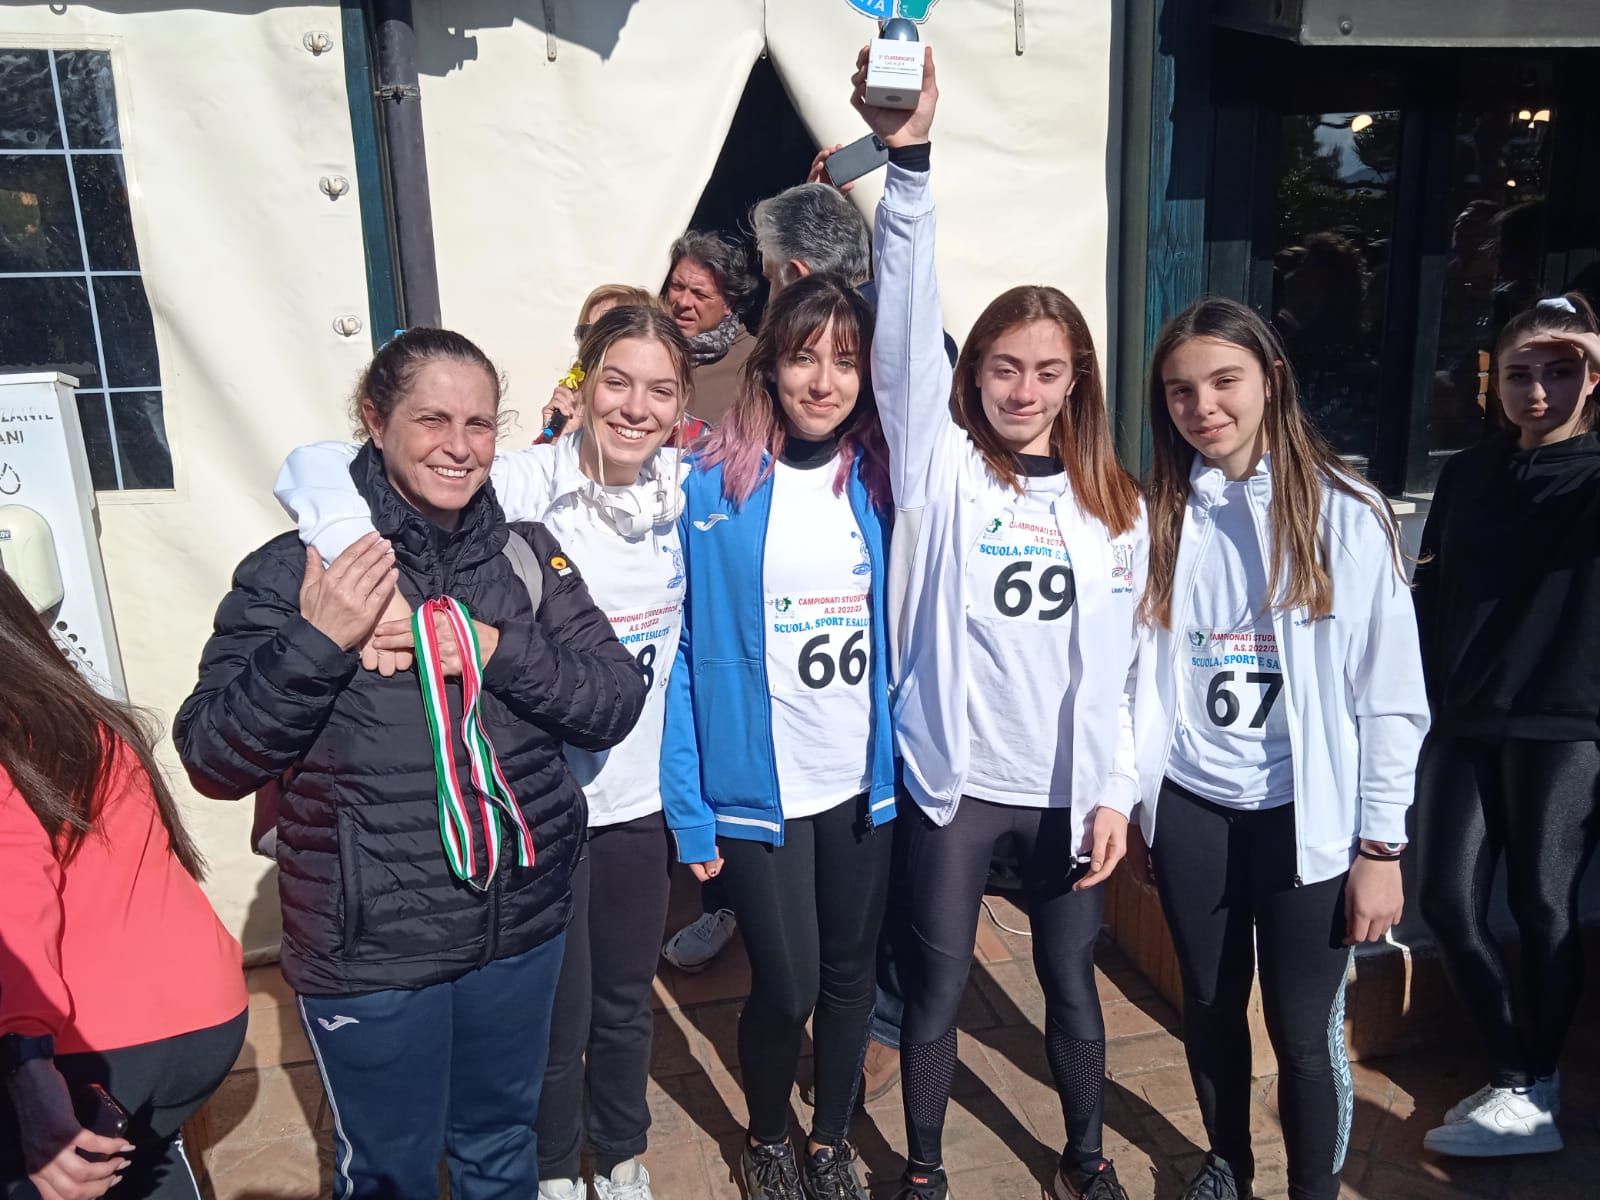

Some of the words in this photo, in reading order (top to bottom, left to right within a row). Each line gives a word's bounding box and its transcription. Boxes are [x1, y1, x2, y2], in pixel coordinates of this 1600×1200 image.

[980, 543, 1022, 558] SCUOLA,
[1024, 545, 1053, 558] SPORT
[994, 560, 1077, 621] 69
[798, 596, 841, 606] CAMPIONATI
[824, 606, 836, 615] A.S.
[774, 621, 814, 633] SCUOLA,
[815, 616, 844, 628] SPORT
[619, 632, 645, 645] SPORT
[1233, 643, 1247, 652] A.S.
[798, 629, 868, 690] 66
[1191, 656, 1222, 668] SCUOLA,
[1223, 654, 1256, 665] SPORT
[1257, 656, 1265, 667] E
[1206, 670, 1284, 729] 67
